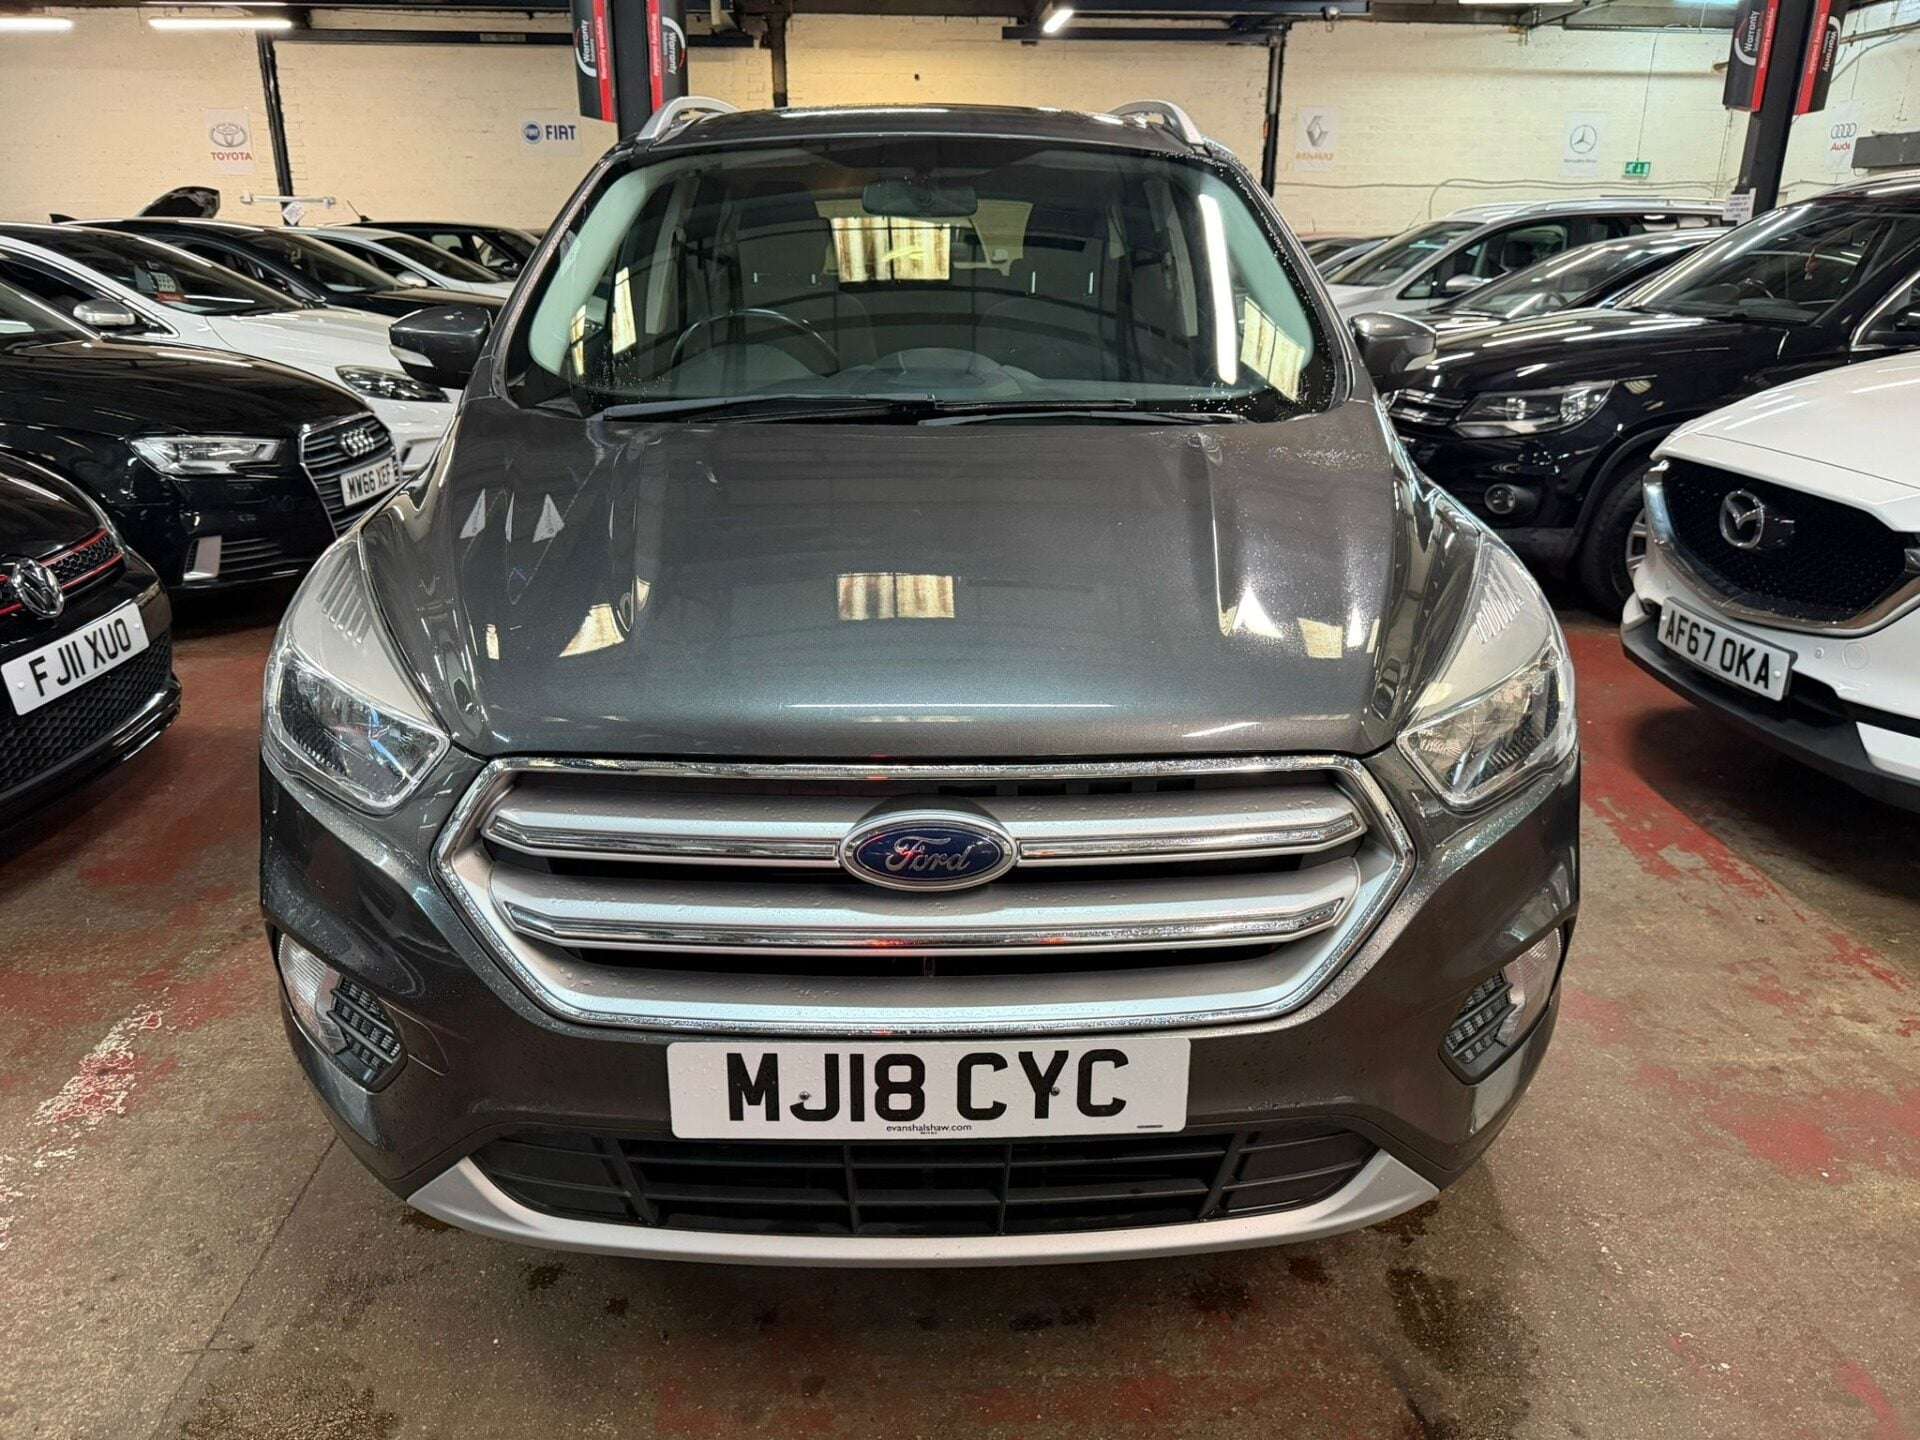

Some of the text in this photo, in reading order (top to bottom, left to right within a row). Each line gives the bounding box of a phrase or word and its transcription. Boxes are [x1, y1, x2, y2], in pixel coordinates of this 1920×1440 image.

[581, 19, 591, 63] Warranty
[1743, 10, 1760, 52] Warranty
[1822, 31, 1838, 73] Warranty
[668, 31, 677, 75] Warranty
[545, 124, 577, 140] FIAT
[210, 151, 253, 161] TOYOTA
[347, 470, 376, 500] MW66
[28, 618, 132, 698] FJ11 XUO
[1664, 610, 1770, 690] AF67 OKA
[884, 835, 972, 872] Ford
[726, 1048, 1129, 1122] MJ18 CYC
[886, 1123, 972, 1133] evanshalshaw.com
